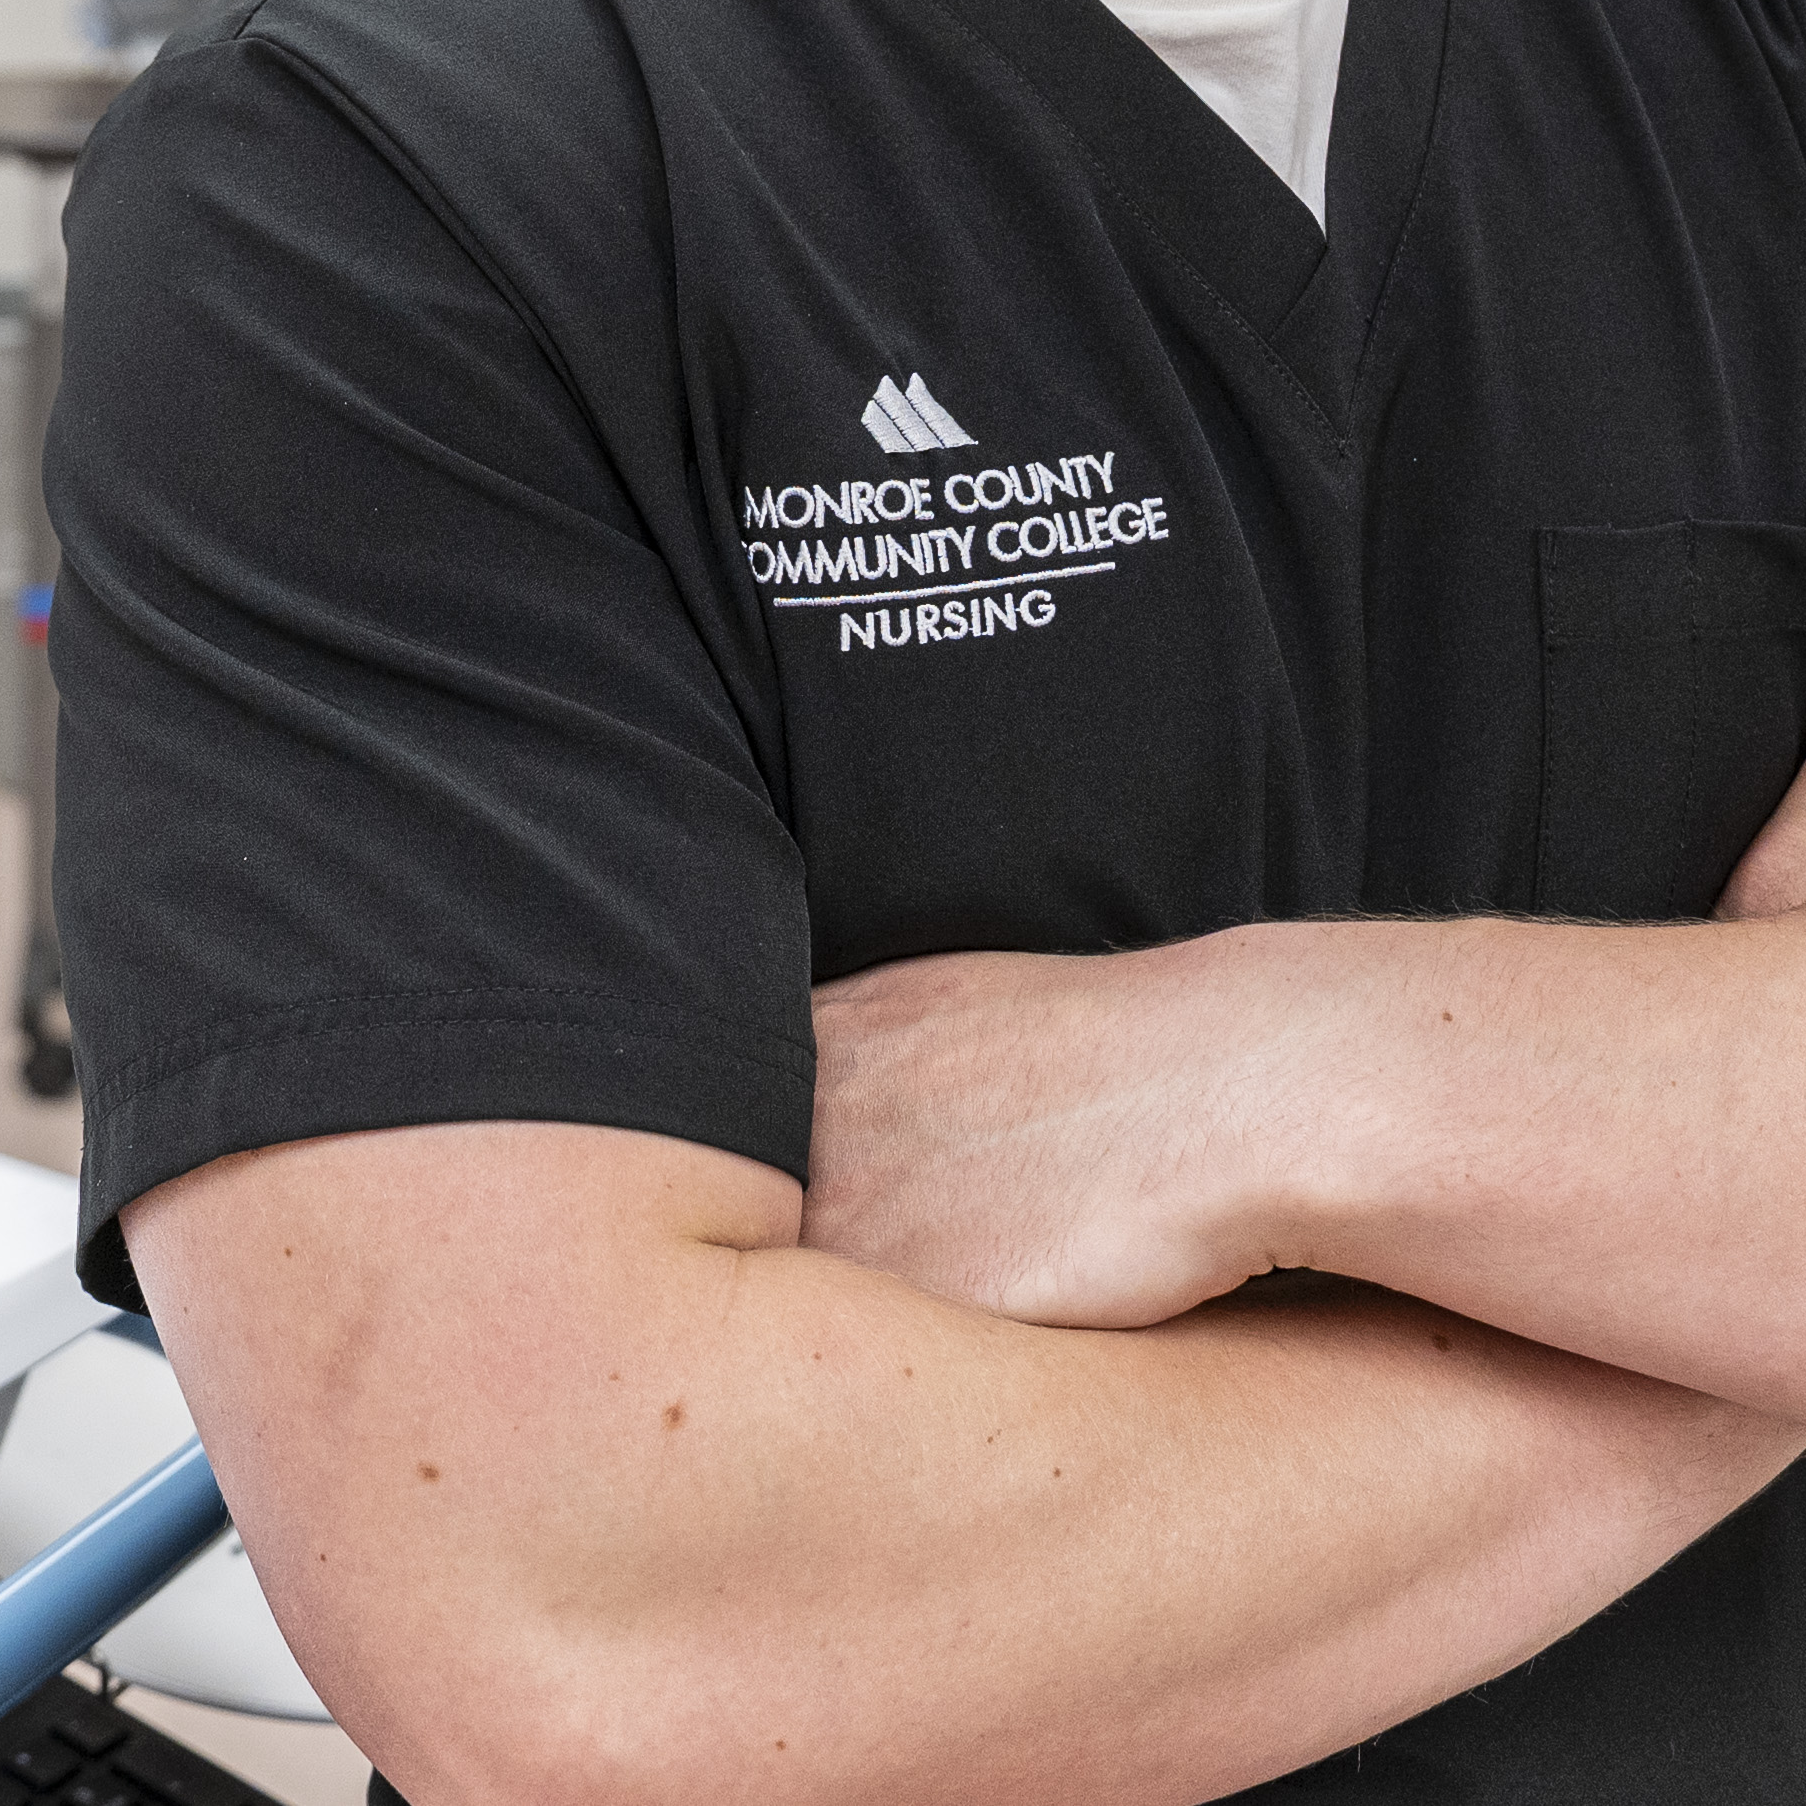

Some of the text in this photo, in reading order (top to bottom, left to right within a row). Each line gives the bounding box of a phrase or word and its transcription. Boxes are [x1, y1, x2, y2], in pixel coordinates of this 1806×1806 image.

[744, 451, 1115, 529] MONROE COUNTY
[741, 497, 1169, 584] OMMUNITY COLLEGE
[840, 589, 1056, 652] NURSING
